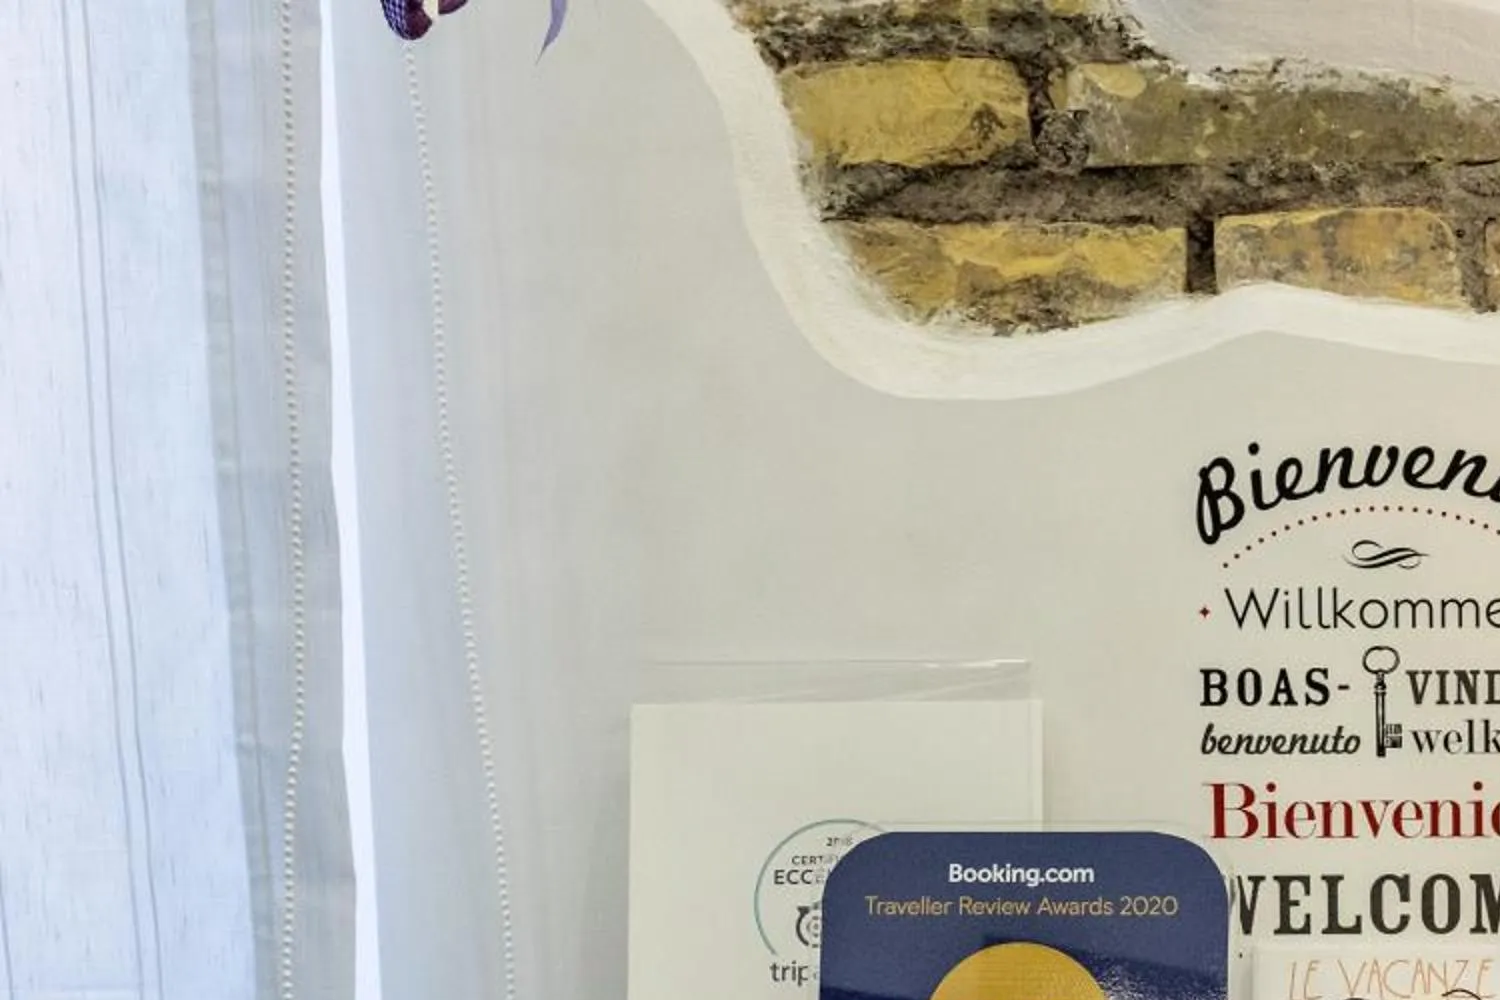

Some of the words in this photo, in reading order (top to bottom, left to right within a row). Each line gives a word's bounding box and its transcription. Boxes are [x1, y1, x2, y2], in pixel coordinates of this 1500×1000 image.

[1200, 668, 1350, 706] BOAS-
[1201, 723, 1361, 755] benvenuto
[948, 863, 1095, 887] Booking.com
[864, 895, 953, 917] Traveller
[959, 895, 1031, 917] Review
[1036, 895, 1114, 917] Awards
[1119, 895, 1179, 917] 2020
